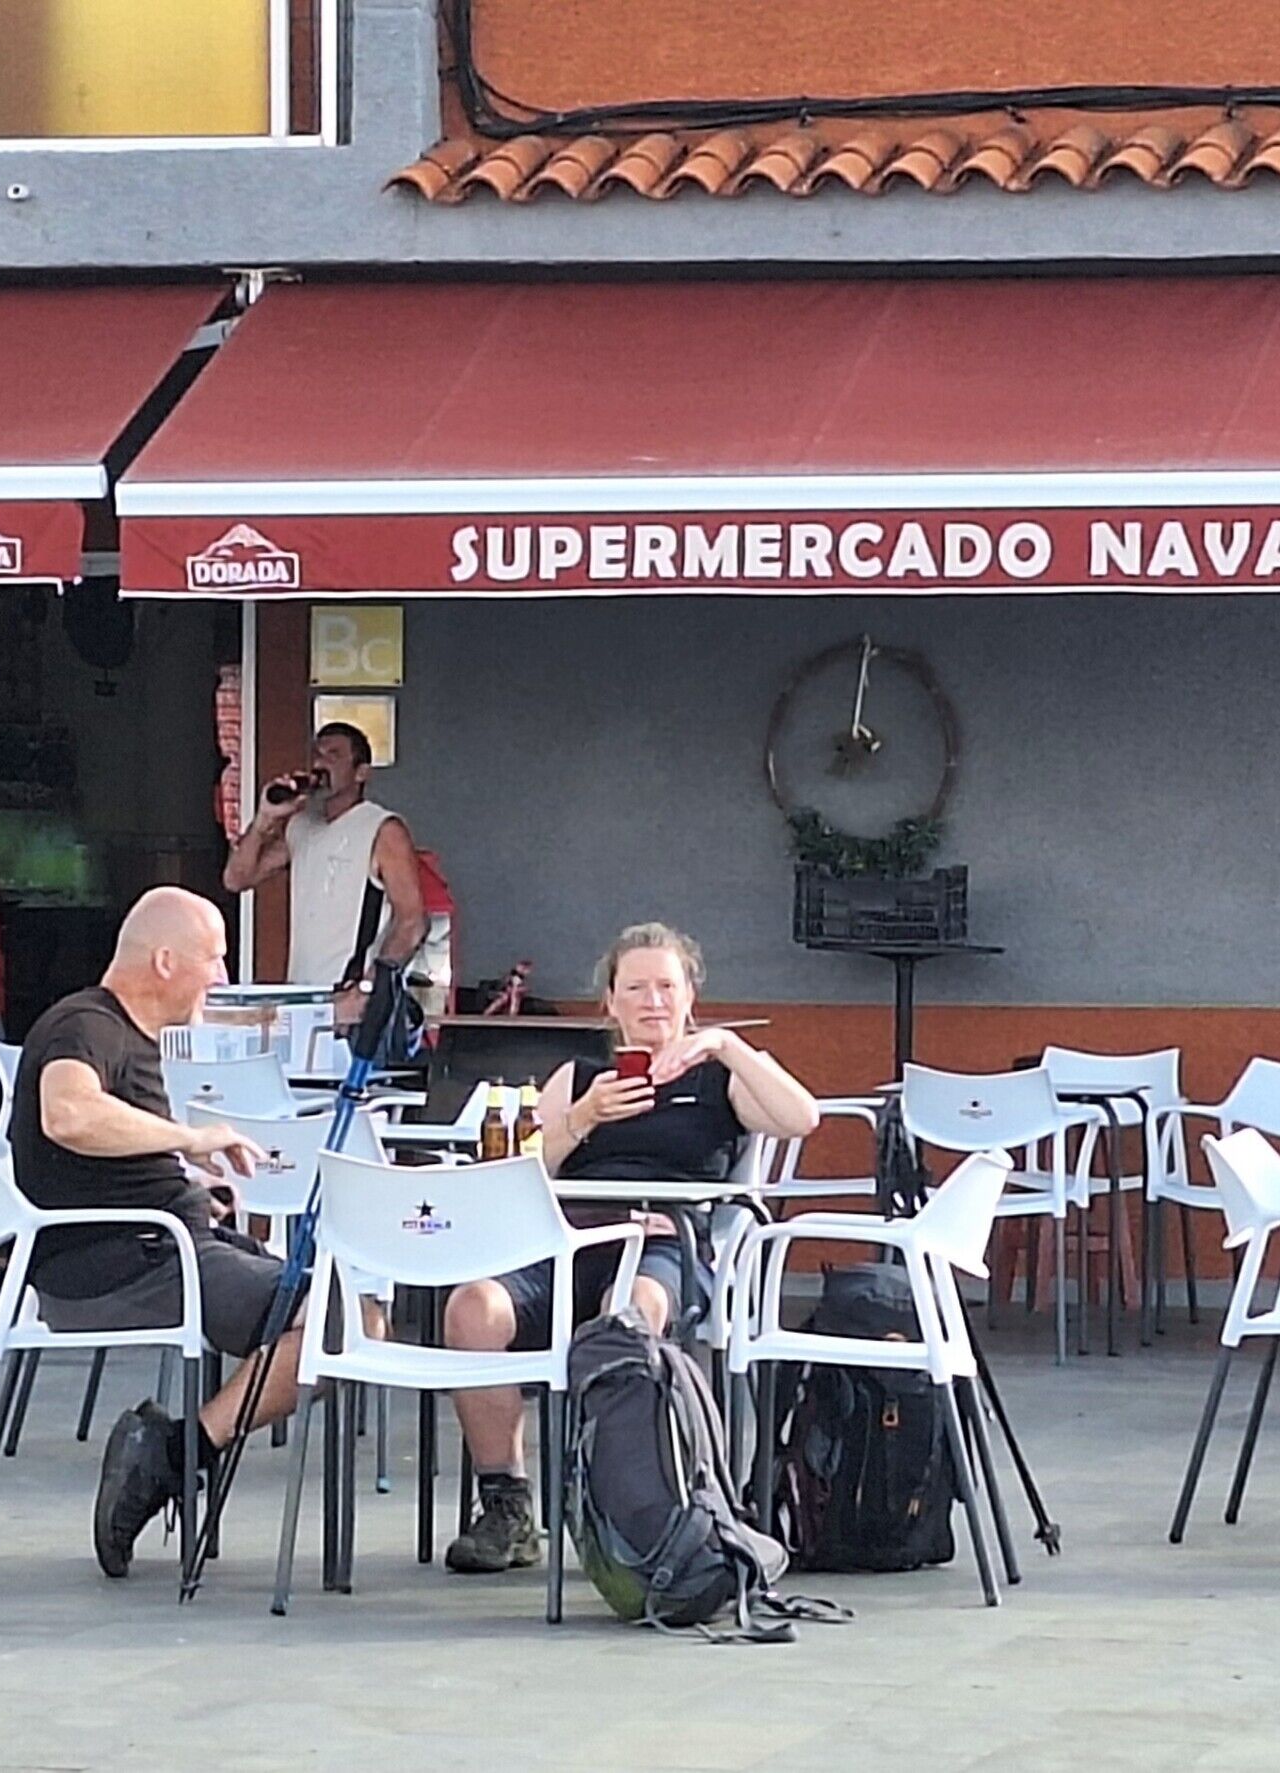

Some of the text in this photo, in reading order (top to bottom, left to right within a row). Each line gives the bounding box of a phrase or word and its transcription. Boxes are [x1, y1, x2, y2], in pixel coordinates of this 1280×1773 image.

[194, 560, 290, 584] DORADA
[451, 522, 1052, 582] SUPERMERCADO
[318, 613, 394, 677] Bc
